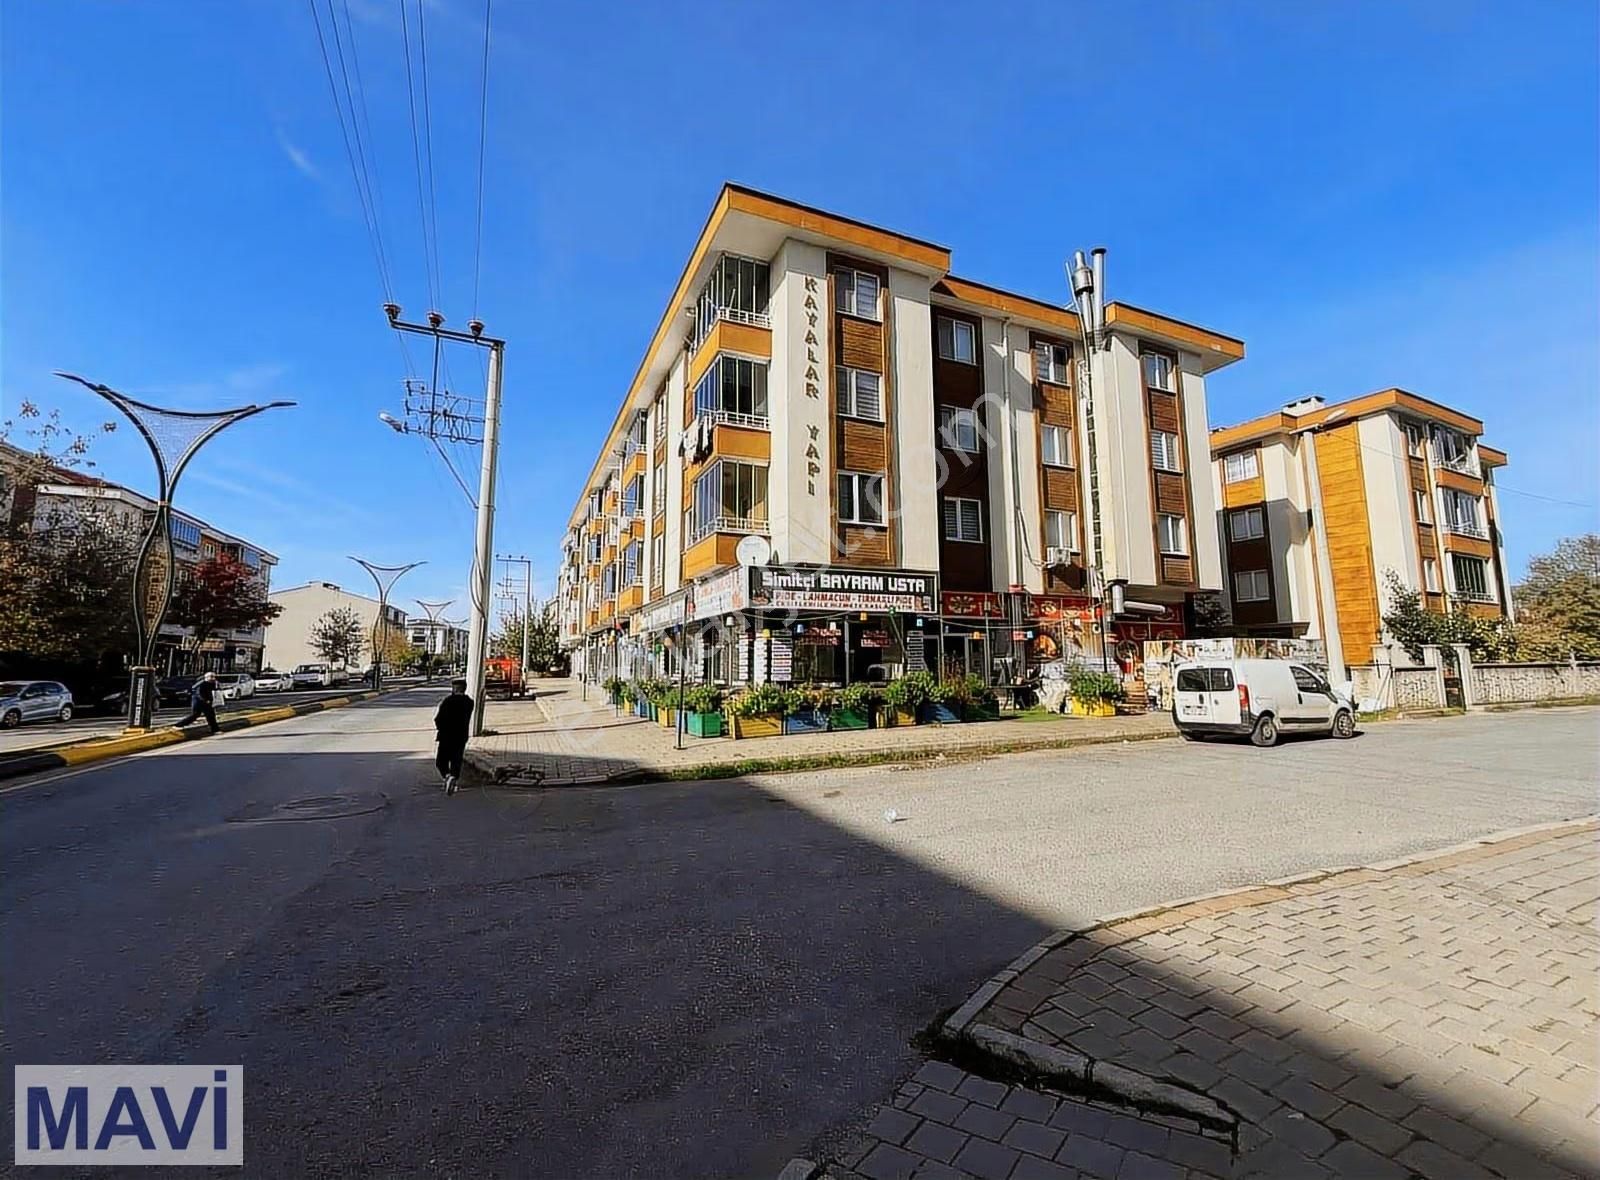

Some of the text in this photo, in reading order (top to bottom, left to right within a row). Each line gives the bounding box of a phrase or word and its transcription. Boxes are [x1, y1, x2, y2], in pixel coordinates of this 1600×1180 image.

[804, 274, 819, 400] KAYALAR
[762, 571, 925, 593] Simitçi BAYRAM USTA
